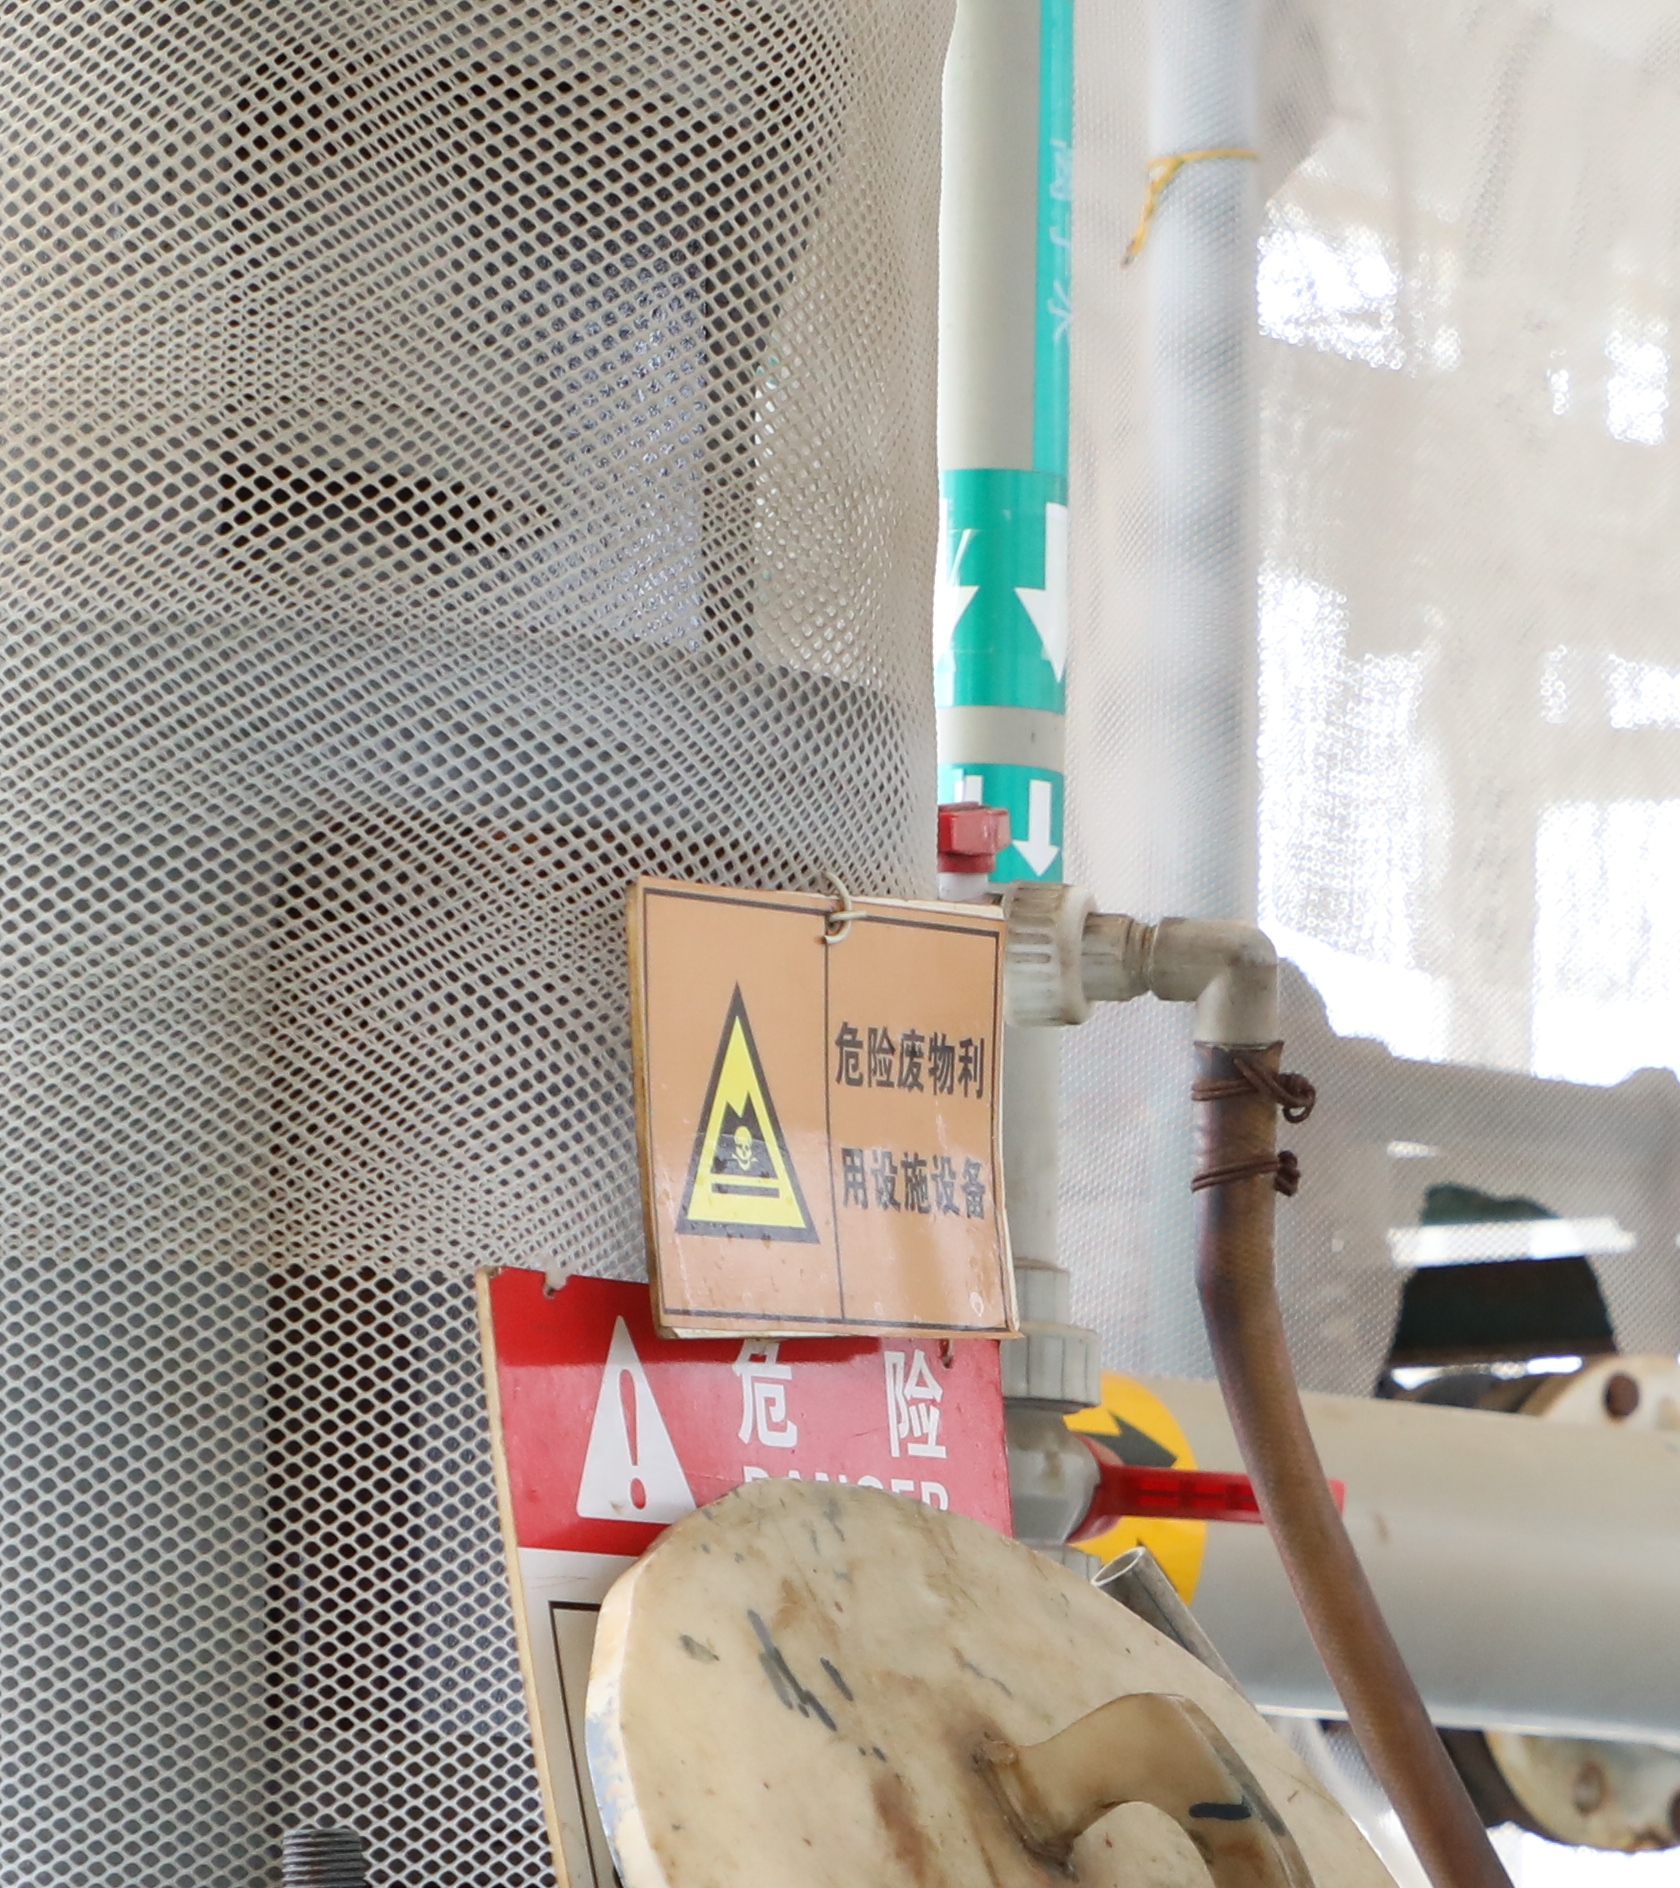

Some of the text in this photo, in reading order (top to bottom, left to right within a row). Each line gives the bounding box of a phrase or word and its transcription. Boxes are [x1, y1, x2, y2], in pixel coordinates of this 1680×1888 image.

[835, 1021, 985, 1099] 危险废物利
[841, 1147, 986, 1219] 用设施设备
[731, 1342, 947, 1459] 危险
